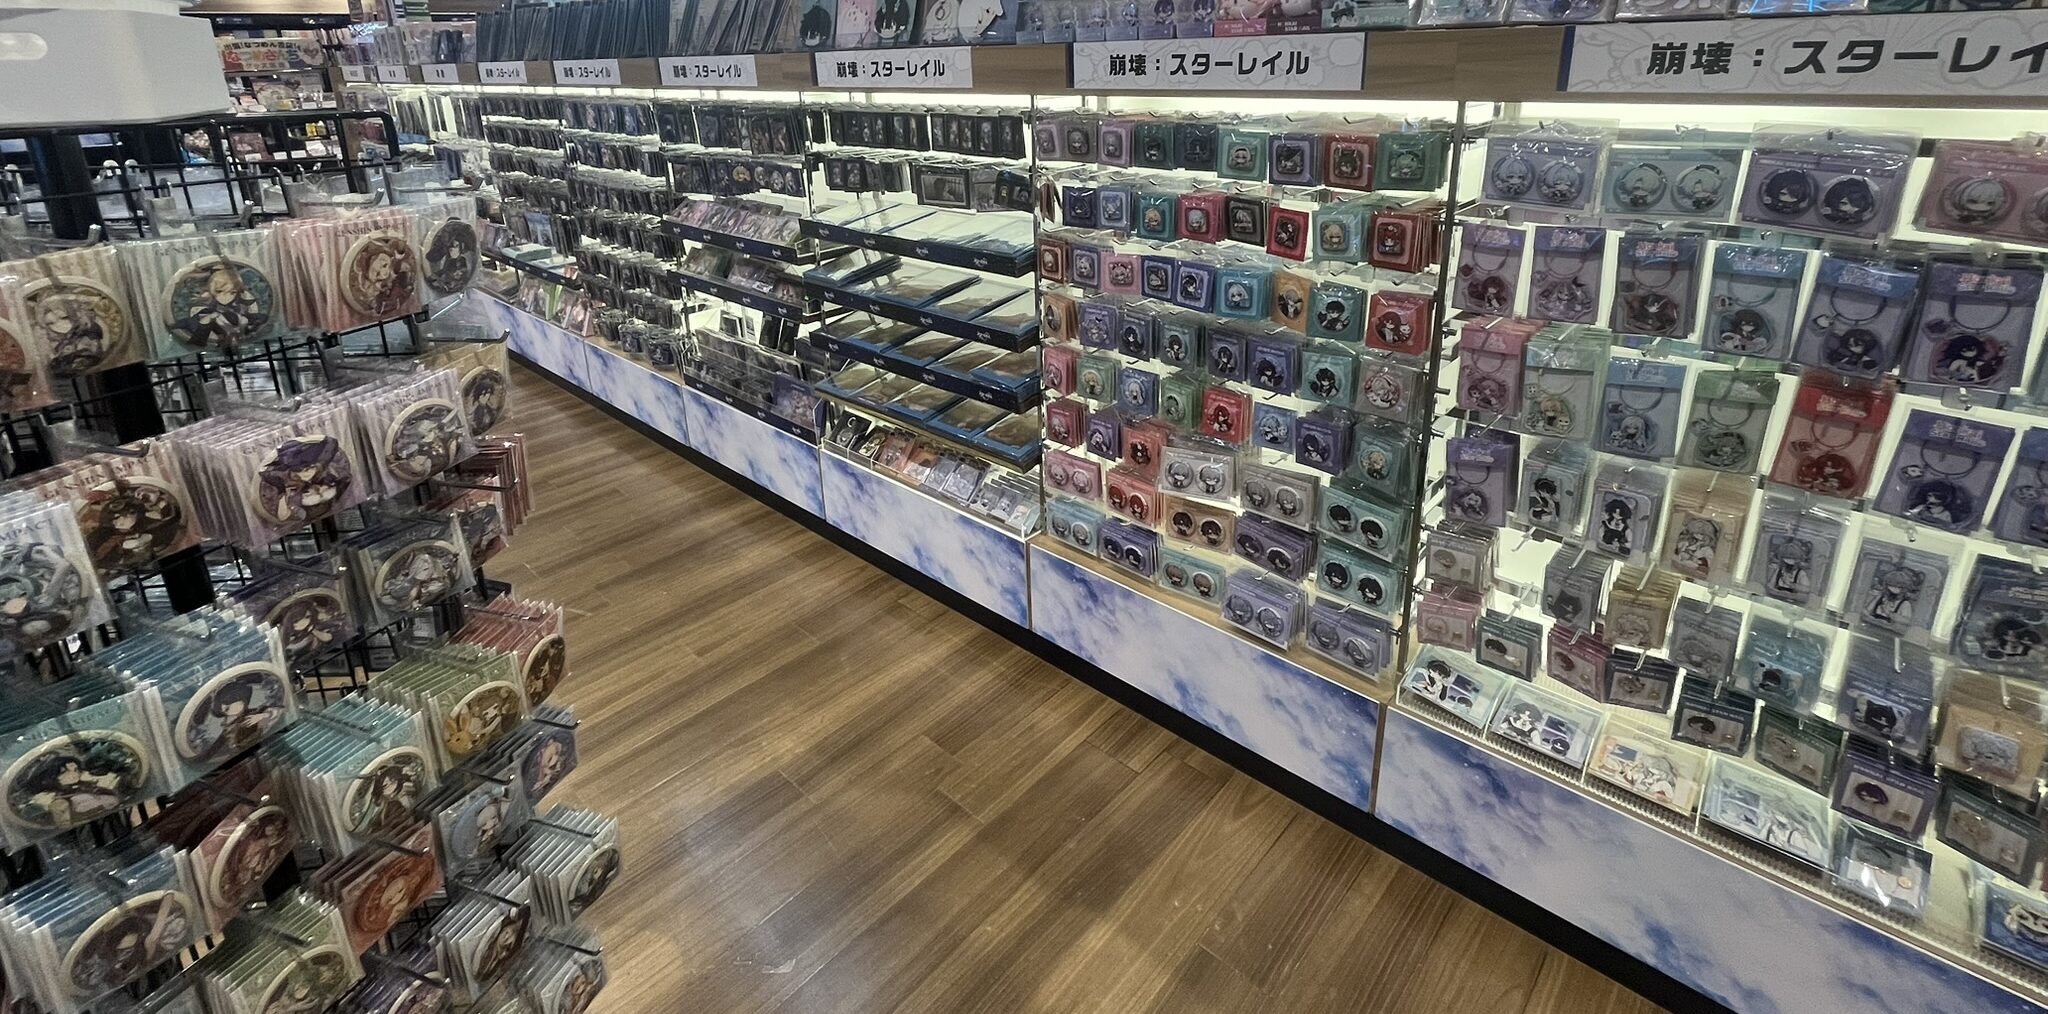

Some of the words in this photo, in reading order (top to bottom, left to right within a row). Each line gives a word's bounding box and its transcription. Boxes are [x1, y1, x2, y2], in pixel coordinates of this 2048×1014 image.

[1109, 51, 1310, 76] 崩壊：スターレイル
